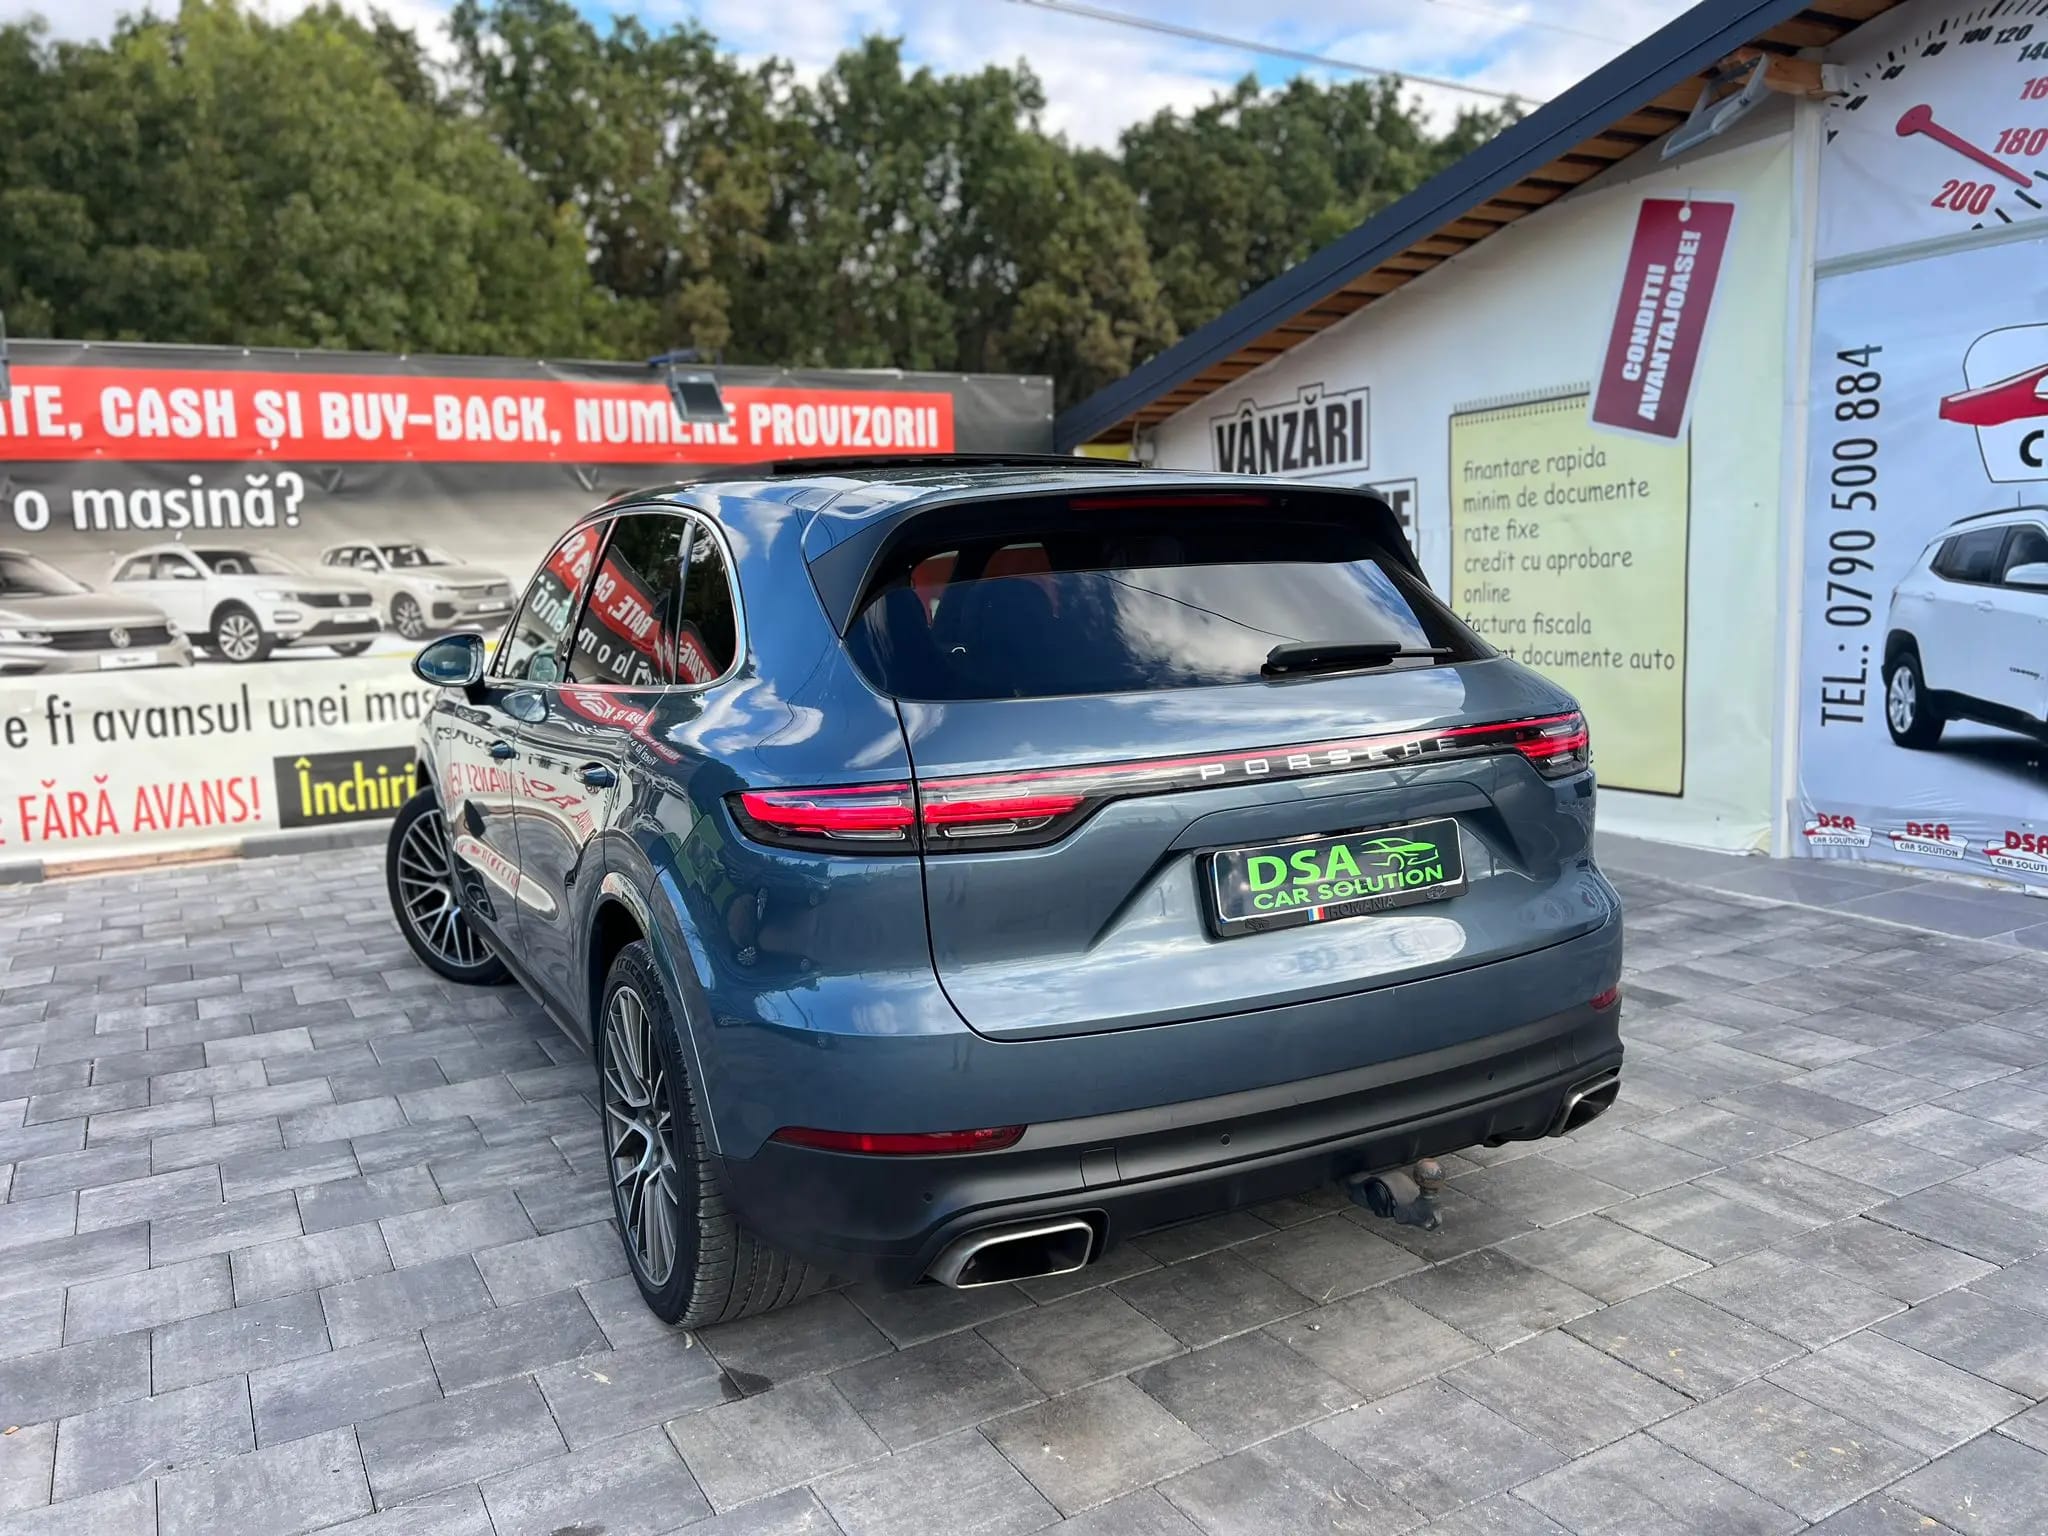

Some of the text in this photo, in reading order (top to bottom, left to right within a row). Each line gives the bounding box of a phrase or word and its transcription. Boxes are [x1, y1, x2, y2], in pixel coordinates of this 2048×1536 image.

[1994, 24, 2034, 45] 120
[1994, 128, 2048, 156] 180
[1931, 180, 1995, 215] 200
[1638, 230, 1701, 421] AVANTAJOASE!
[1835, 344, 1883, 422] 884
[101, 386, 237, 439] CASH
[254, 389, 304, 450] ȘI
[749, 402, 938, 448] PROVIZORII
[1216, 394, 1362, 475] VÂNZĂRI
[1464, 445, 1606, 482] finantare rapida
[1831, 438, 1878, 511] 500
[14, 470, 304, 541] o mașină?
[1464, 477, 1650, 513] minim de documente
[1464, 517, 1540, 543] rate fixe
[1464, 547, 1633, 576] credit cu aprobare
[1825, 529, 1876, 627] 0790
[1464, 582, 1511, 604] online
[1465, 612, 1592, 637] factura fiscala
[1522, 643, 1624, 668] documente
[1630, 649, 1675, 670] auto
[45, 694, 75, 746] fi
[93, 683, 252, 743] avansul
[268, 683, 350, 729] unei
[1200, 737, 1457, 781] PORSCHE
[18, 773, 120, 843] FĂRĂ
[132, 774, 261, 833] AVANS!
[1816, 812, 1857, 830] DSA
[1813, 836, 1866, 846] CAR SOLUTION
[1906, 820, 1951, 841] DSA
[1899, 841, 1959, 858] CAR SOLUTION
[1996, 857, 2014, 868] CAR
[1247, 844, 1362, 892] DSA
[1253, 863, 1444, 910] CAR SOLUTION
